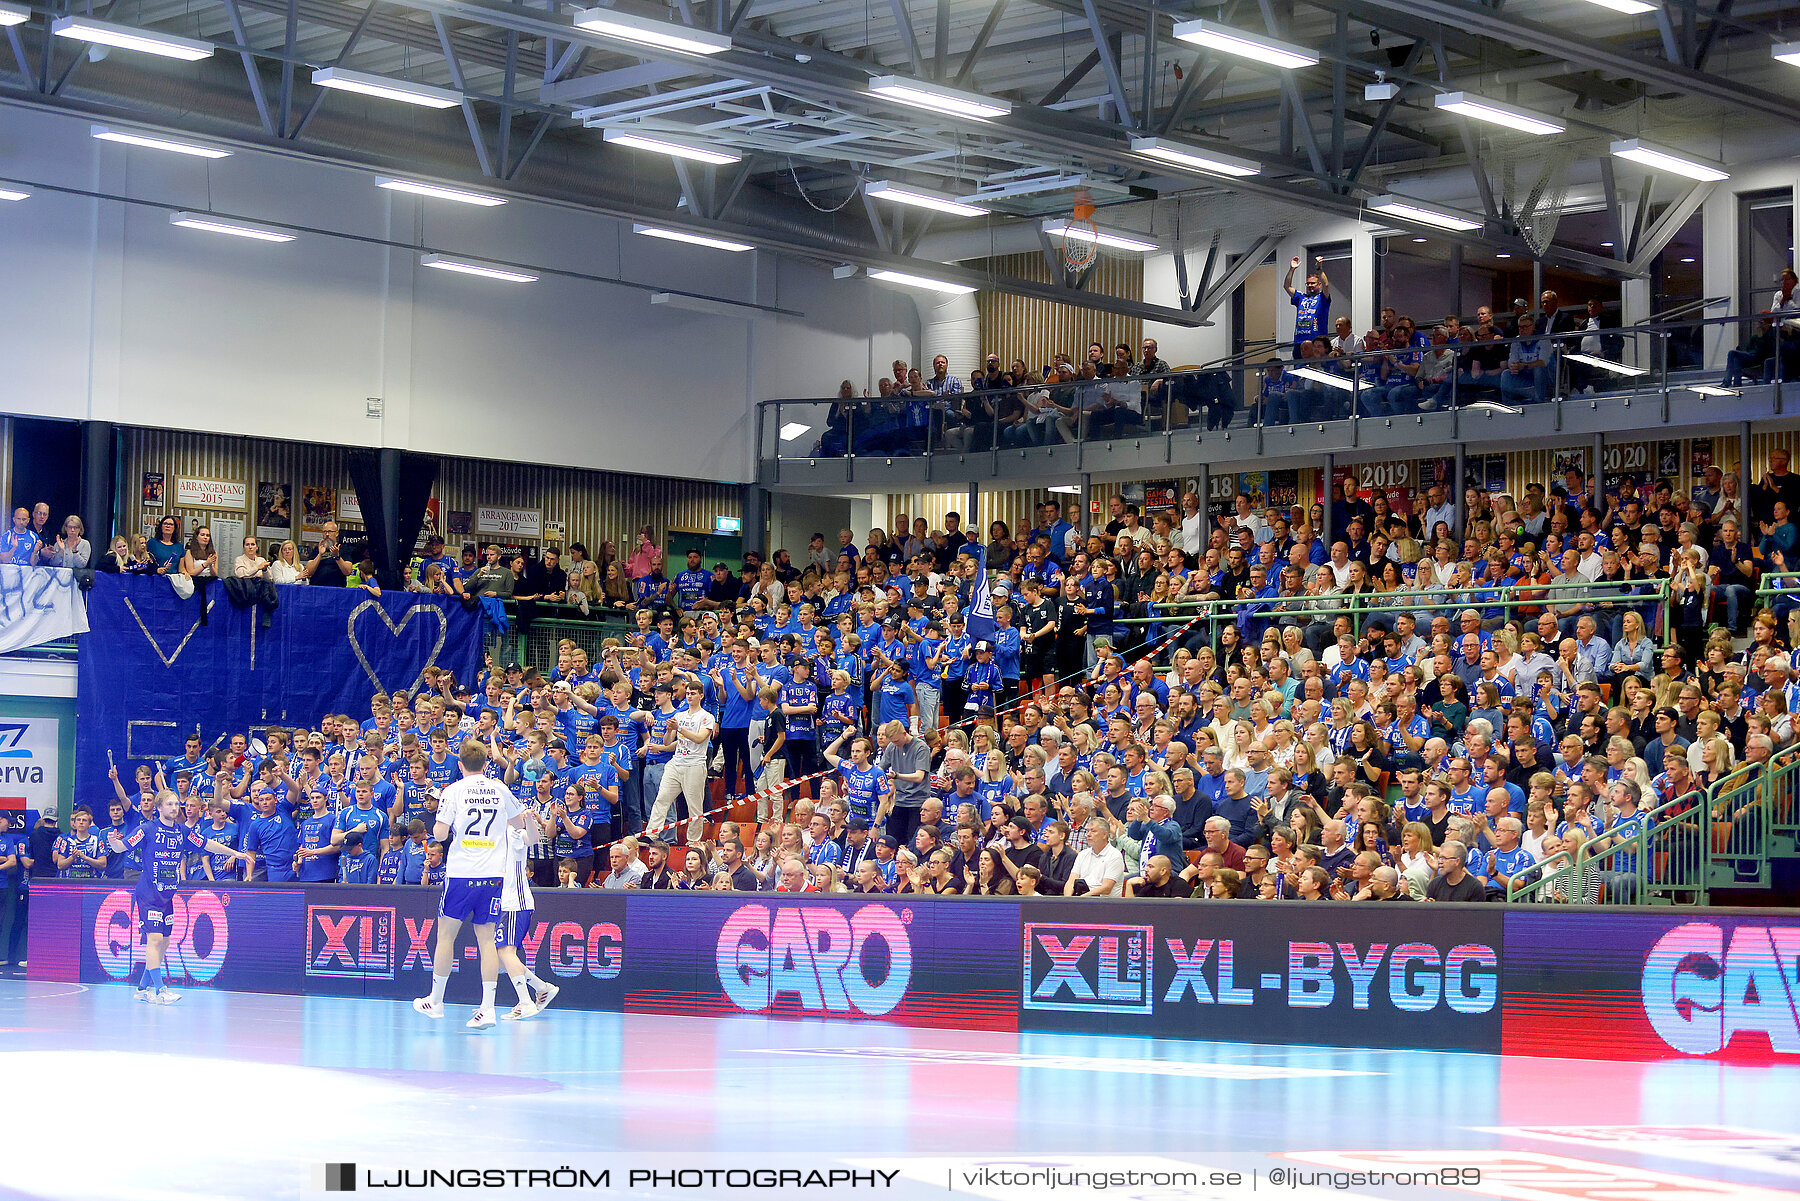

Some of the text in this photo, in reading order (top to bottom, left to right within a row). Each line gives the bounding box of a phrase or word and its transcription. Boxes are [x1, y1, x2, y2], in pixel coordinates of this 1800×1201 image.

[1362, 463, 1409, 488] 2019
[180, 481, 244, 495] ARRANGEMANG
[1146, 488, 1167, 497] GAME
[200, 493, 223, 504] 2015
[1146, 497, 1177, 506] FESTIVAL
[480, 510, 538, 523] ARRANGEMANG
[498, 522, 519, 532] 2017
[680, 573, 689, 581] 69
[0, 766, 44, 784] rva
[398, 769, 407, 778] 25
[202, 778, 211, 786] 10
[408, 790, 417, 798] 10
[467, 788, 496, 796] PALMAR
[465, 797, 491, 805] rondo
[464, 807, 498, 837] 27
[155, 833, 166, 844] 27
[312, 914, 388, 969] XL BYGG
[715, 903, 913, 1016] GARO
[1032, 934, 1142, 1001] XL BYGG
[1163, 937, 1498, 1014] XL-BYGG
